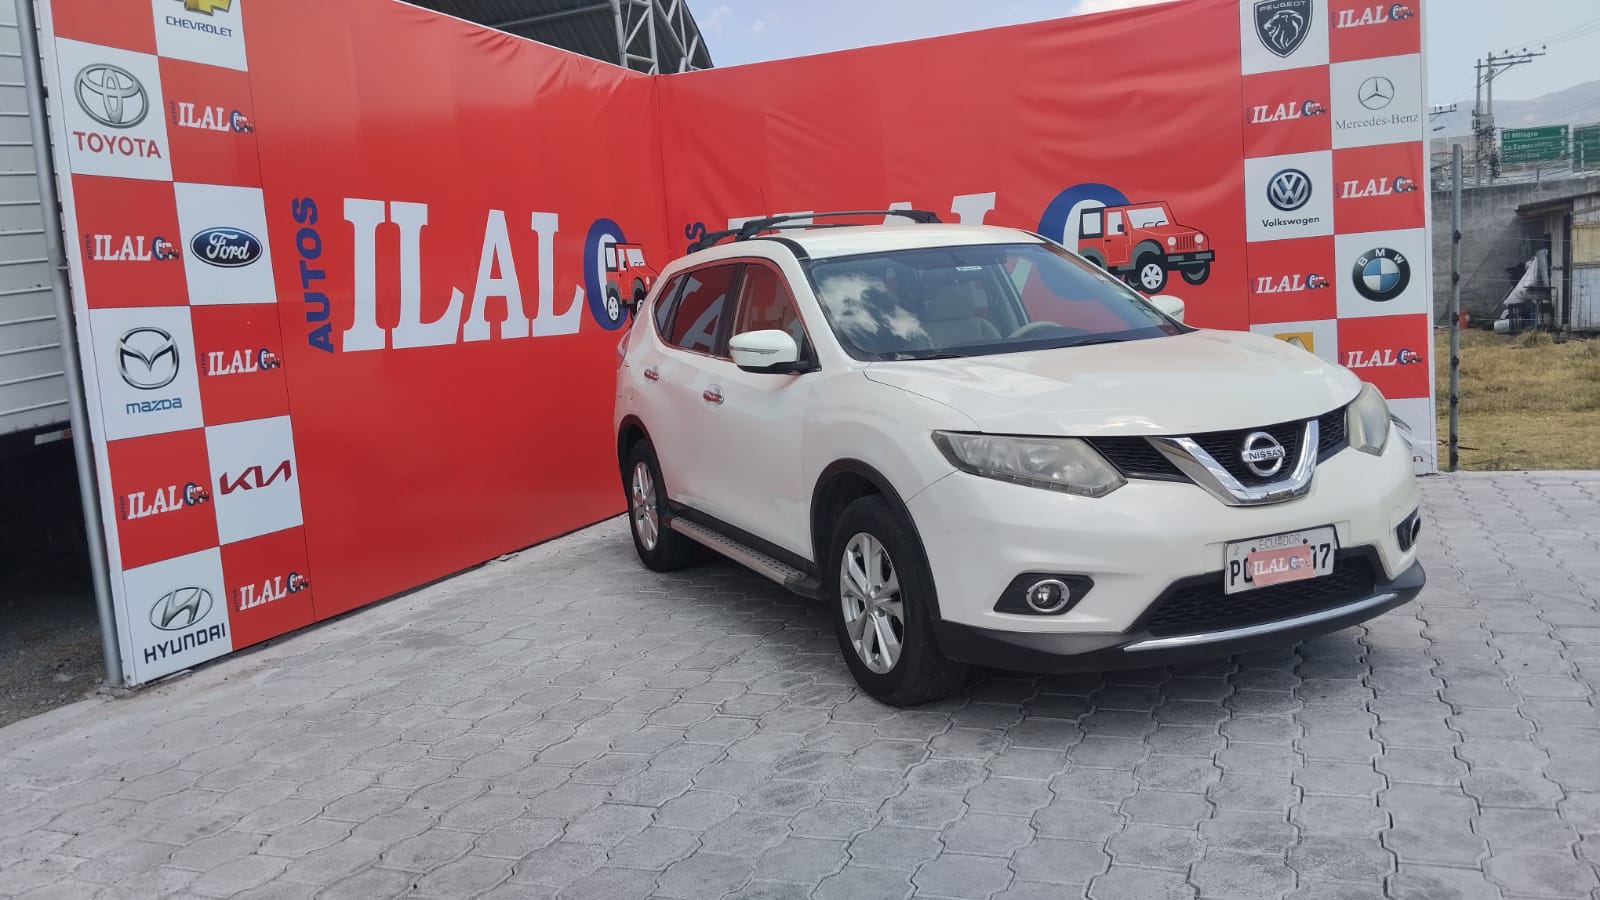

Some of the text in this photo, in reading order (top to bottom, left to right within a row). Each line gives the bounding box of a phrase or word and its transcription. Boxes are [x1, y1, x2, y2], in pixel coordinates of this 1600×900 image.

[1259, 1, 1307, 12] PEUGEOT
[165, 16, 233, 38] CHEVROLET
[1335, 114, 1419, 130] Mercedes-Benz
[73, 131, 162, 159] TOYOTA
[1262, 216, 1320, 228] Volkswagen
[206, 232, 250, 260] Ford
[292, 197, 334, 354] AUTOS
[1249, 449, 1283, 461] NISSAN
[1258, 533, 1301, 551] ECUADOR
[144, 623, 226, 664] HYUNDAI
